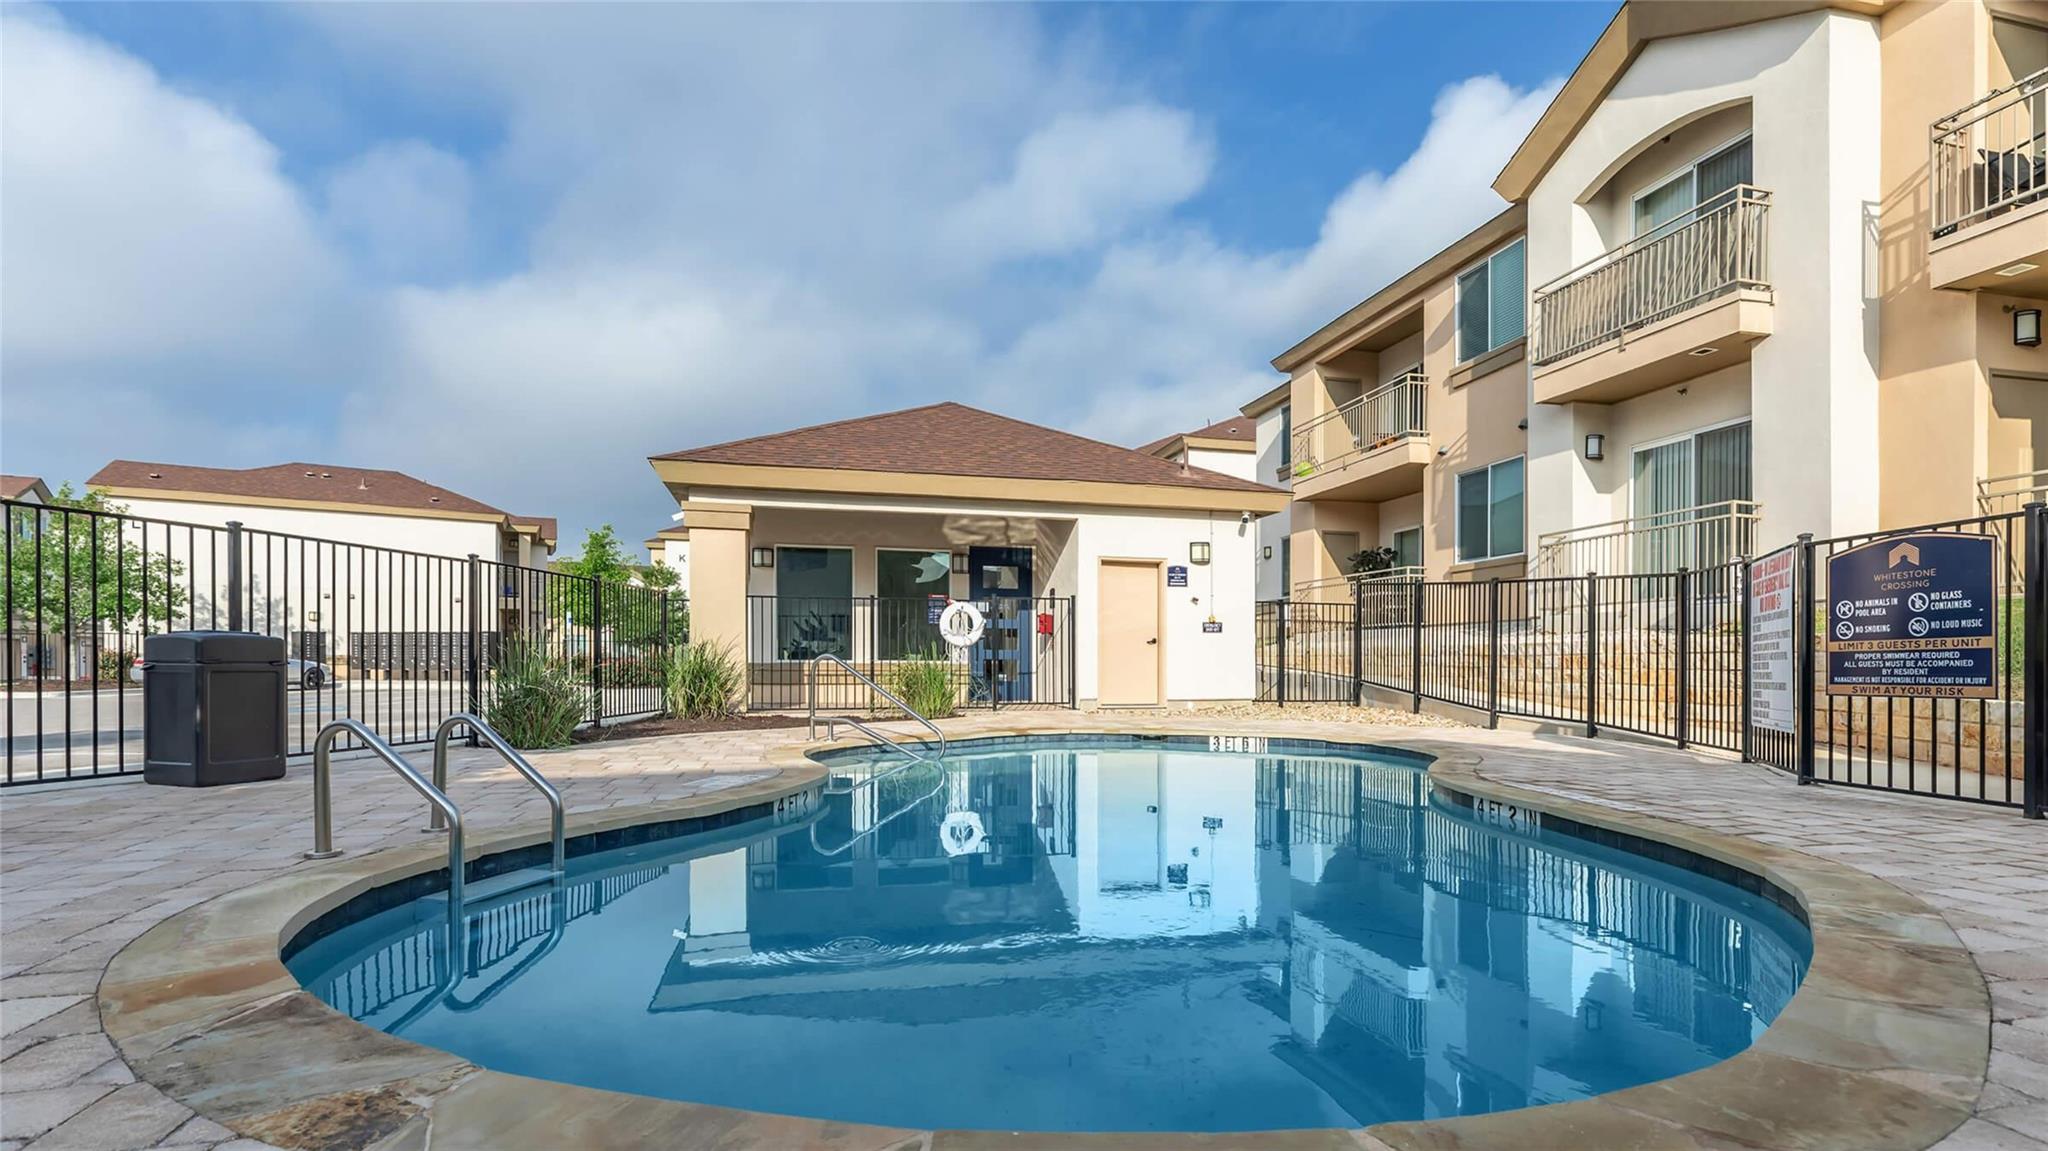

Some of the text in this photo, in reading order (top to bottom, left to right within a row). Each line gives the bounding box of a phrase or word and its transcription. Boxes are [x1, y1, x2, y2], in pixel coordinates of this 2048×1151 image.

[679, 554, 686, 562] K
[1874, 568, 1937, 582] WHITESTONE
[1881, 579, 1930, 591] CROSSING
[1931, 590, 1962, 600] NO GLASS
[1855, 599, 1863, 607] NO
[1864, 598, 1890, 606] ANIMALS
[1930, 600, 1972, 610] CONTAINERS
[1855, 608, 1886, 617] POOL AREA
[1864, 624, 1890, 633] SMOKING
[1931, 618, 1983, 629] NO LOUD MUSIC
[1838, 642, 1864, 650] LIMIT
[1877, 640, 1920, 649] GUESTS
[1925, 640, 1947, 648] PER
[1952, 638, 1982, 647] UNIT
[1901, 687, 1931, 695] YOUR
[1936, 687, 1964, 696] RISK
[1478, 798, 1484, 812] 4
[1489, 800, 1502, 816] FT
[1524, 809, 1536, 825] IN
